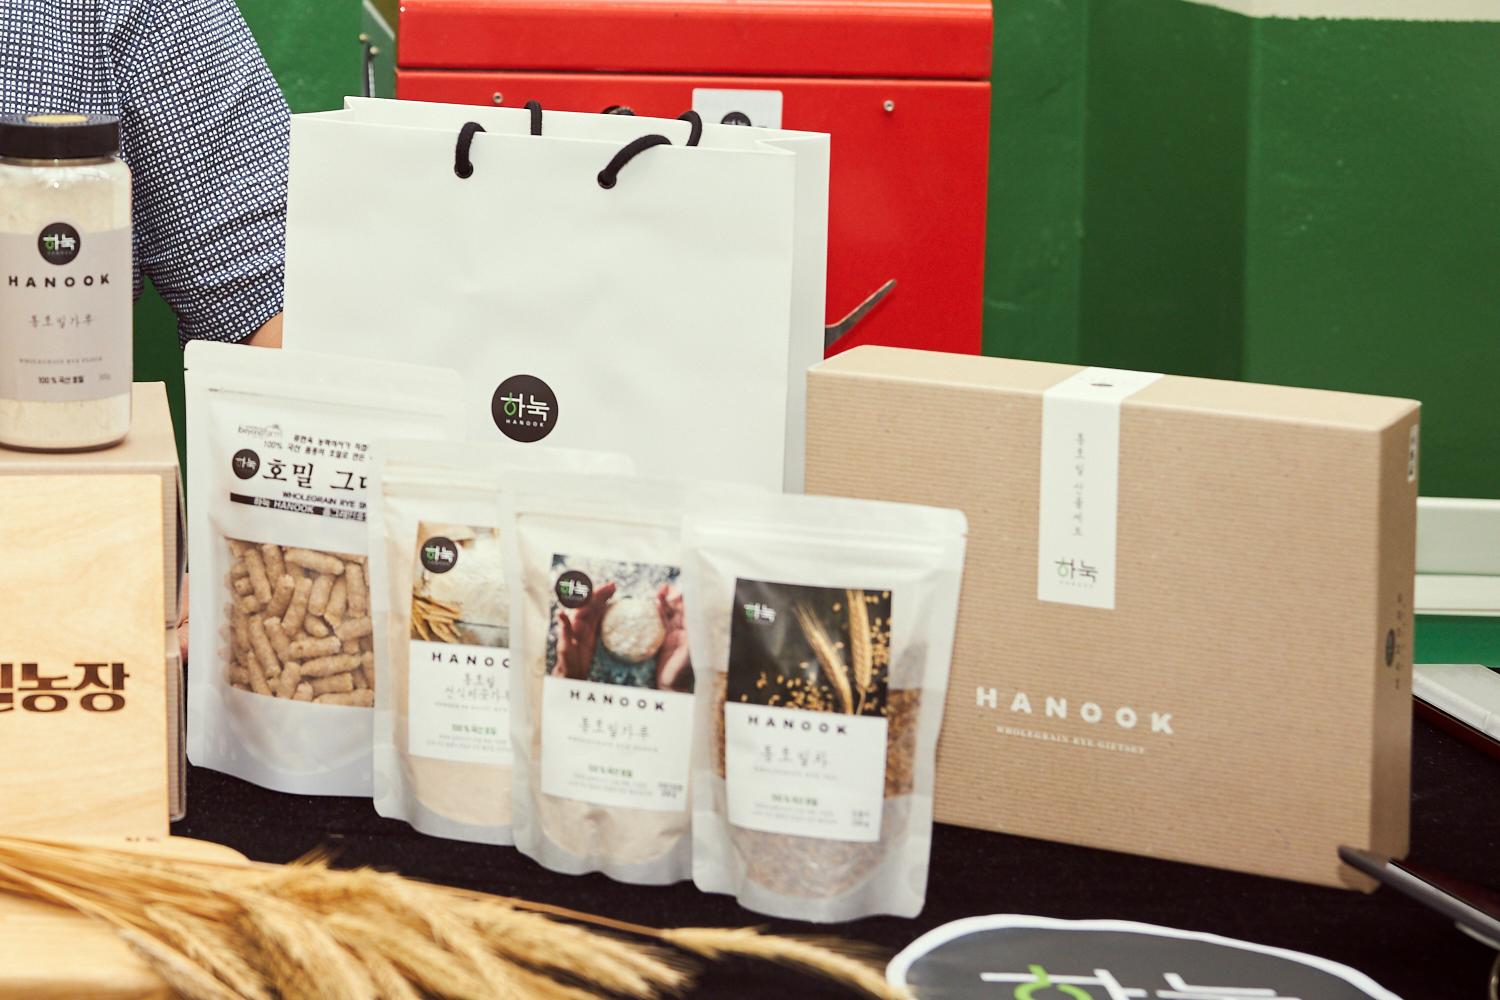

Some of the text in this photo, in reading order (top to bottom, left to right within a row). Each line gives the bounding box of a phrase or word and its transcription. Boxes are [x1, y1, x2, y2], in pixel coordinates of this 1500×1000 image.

[8, 274, 109, 288] HANOOK
[500, 392, 550, 422] 하눅
[505, 419, 545, 427] HANOOK
[262, 458, 314, 489] 호밀
[273, 500, 314, 515] HANOOK
[283, 491, 355, 508] WHOLEGRAIN RYE
[1054, 557, 1098, 582] 하눅
[570, 691, 664, 711] HANOOK
[976, 686, 1174, 735] HANOOK
[748, 716, 847, 735] HANOOK
[996, 725, 1145, 755] WHOLEGRAIN RYE GIFTSET
